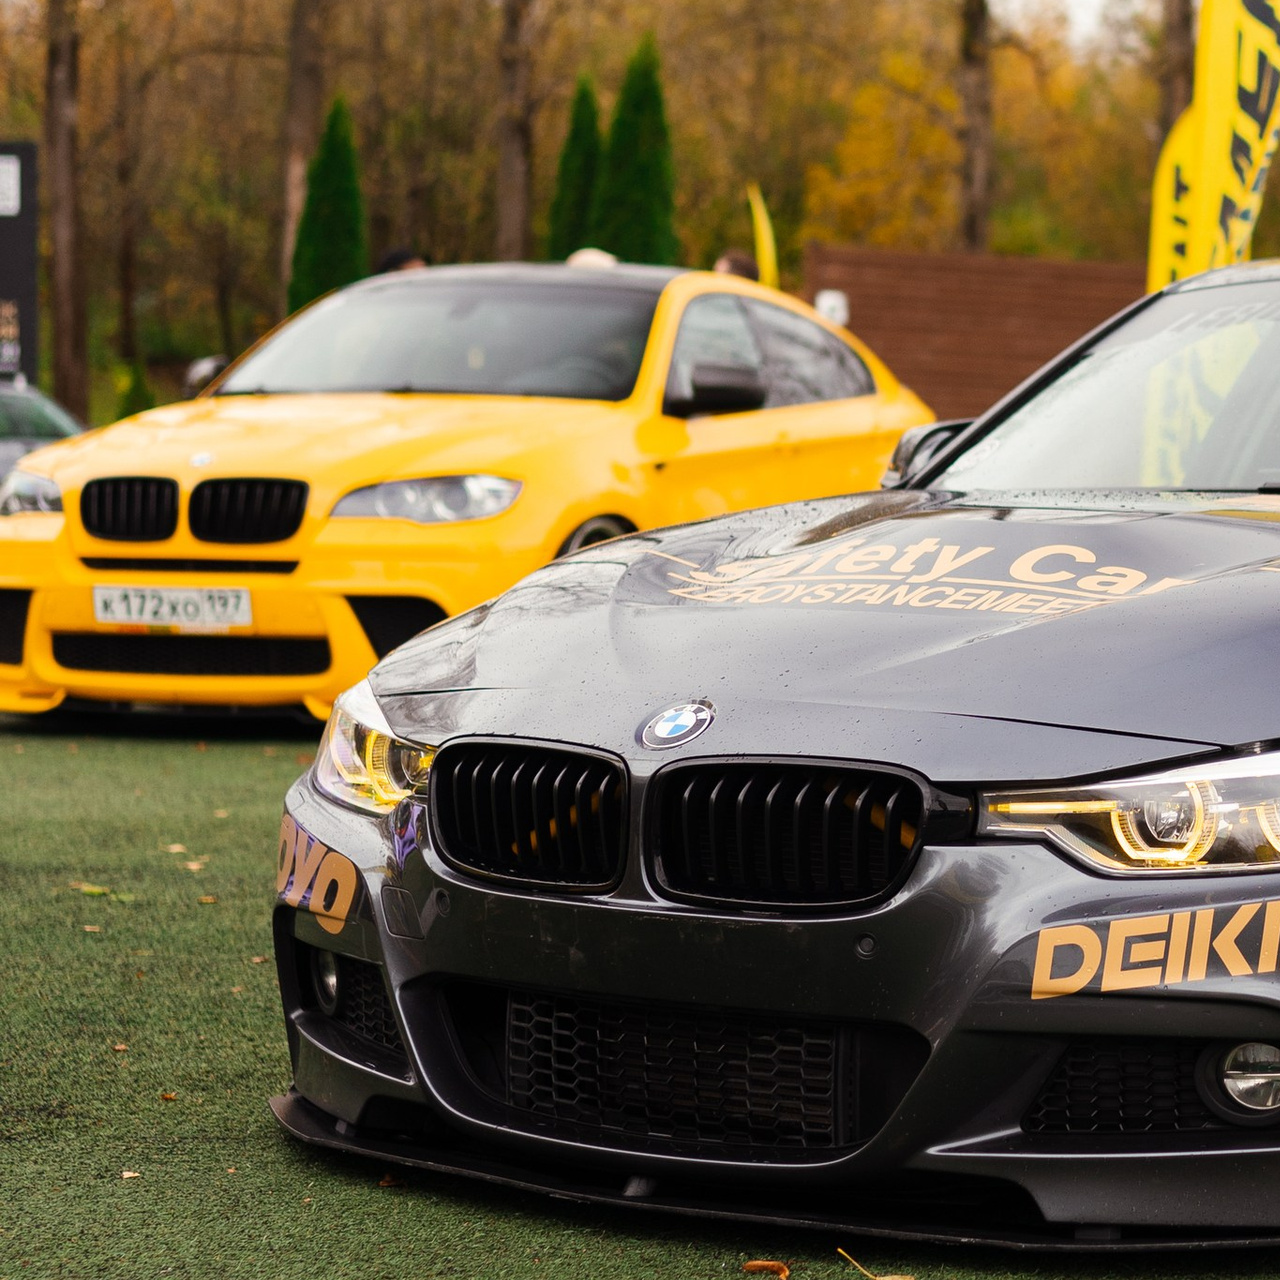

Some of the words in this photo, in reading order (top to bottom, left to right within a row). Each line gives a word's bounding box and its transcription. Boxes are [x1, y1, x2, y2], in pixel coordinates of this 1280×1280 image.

[690, 538, 995, 583] Safety
[1009, 544, 1199, 596] Car
[277, 814, 356, 934] OYO
